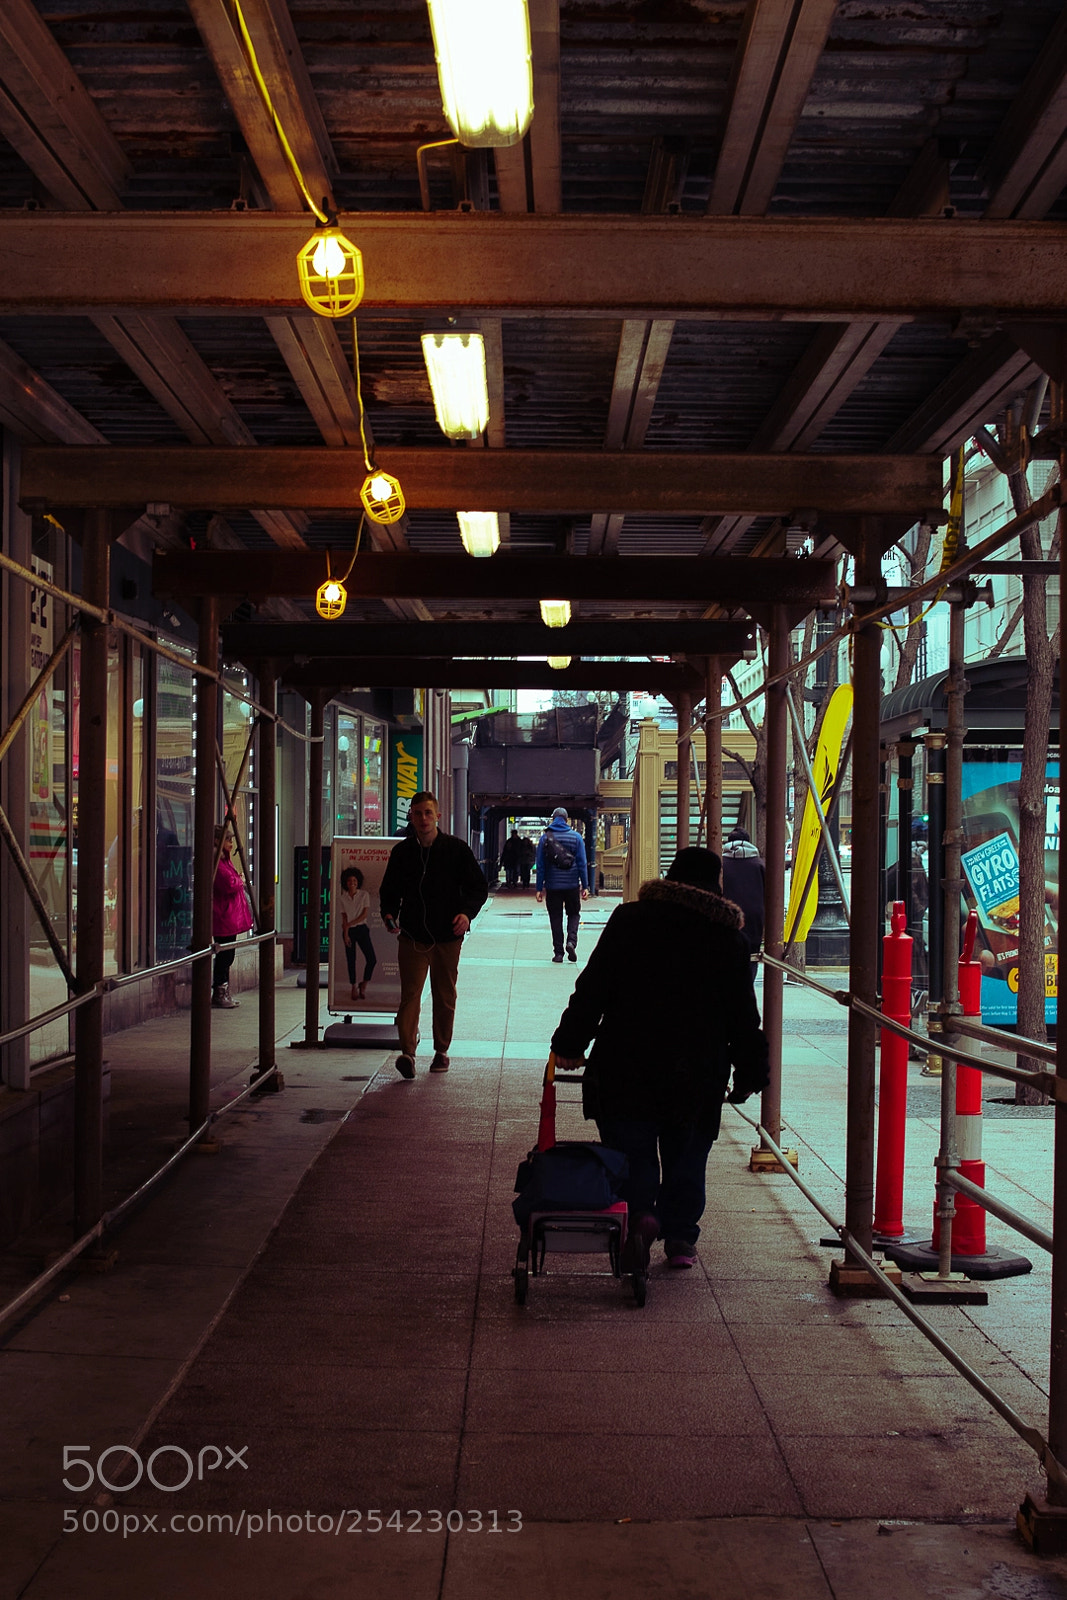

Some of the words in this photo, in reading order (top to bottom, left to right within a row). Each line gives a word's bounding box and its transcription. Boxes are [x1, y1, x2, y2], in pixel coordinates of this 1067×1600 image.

[395, 740, 418, 830] UBWAY
[364, 848, 388, 856] LOSING
[971, 848, 1016, 886] GYRO
[973, 850, 986, 863] NEW
[979, 872, 1015, 902] FLATS
